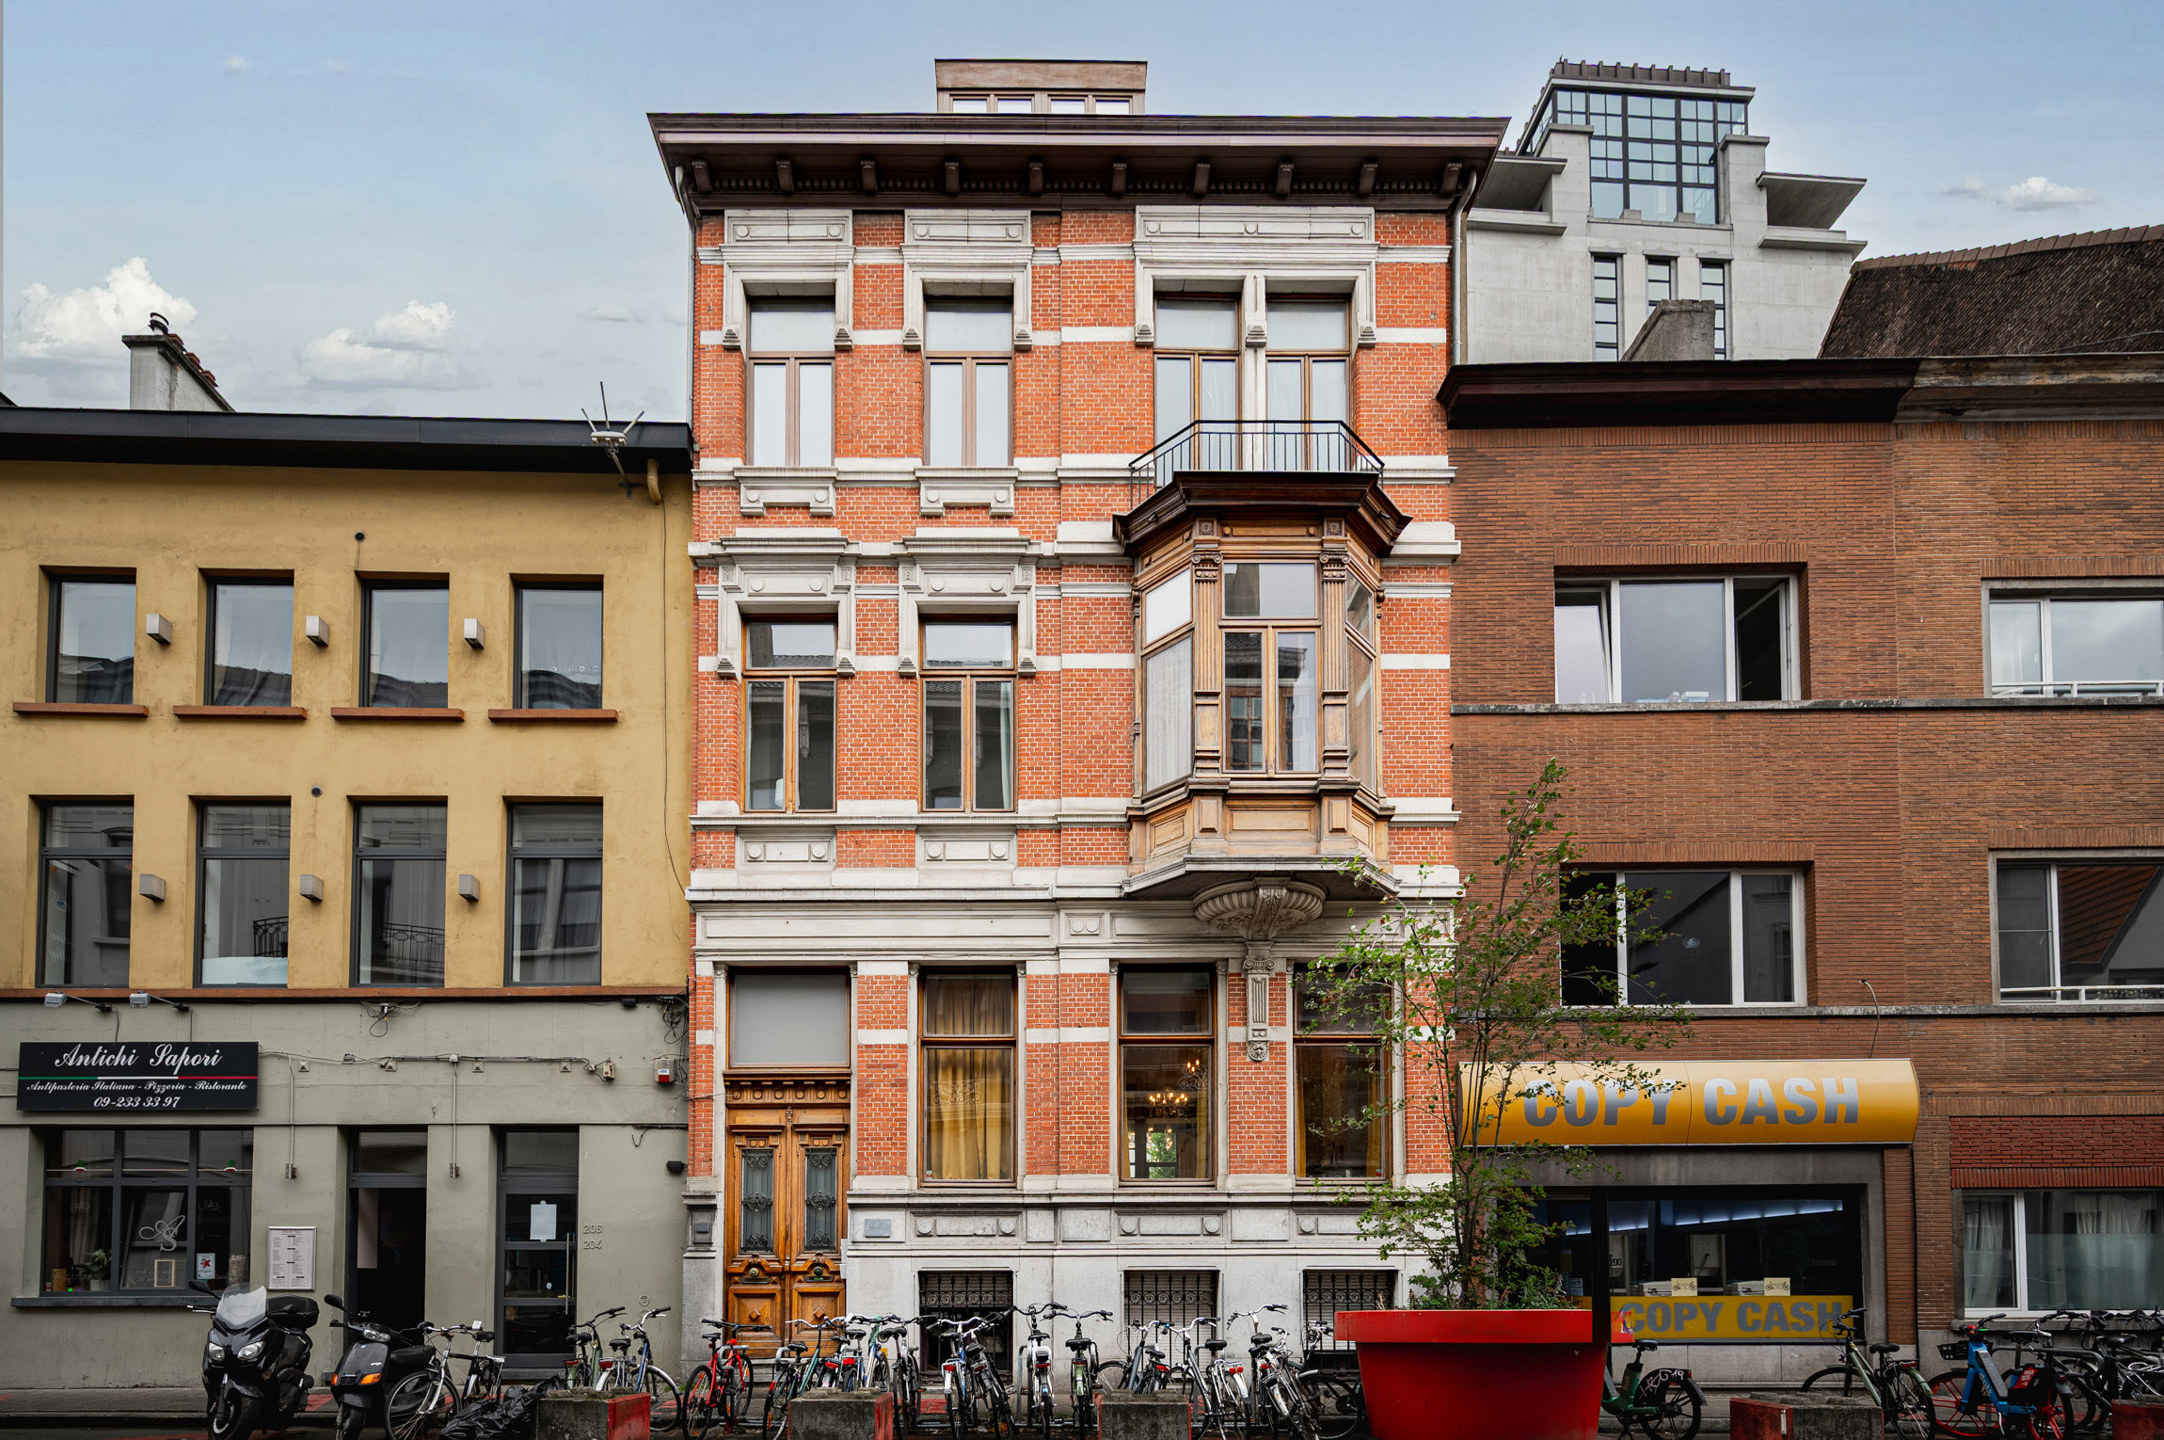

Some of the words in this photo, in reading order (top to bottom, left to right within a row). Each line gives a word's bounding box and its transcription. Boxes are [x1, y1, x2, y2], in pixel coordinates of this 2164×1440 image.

[54, 1044, 139, 1067] Antichi
[149, 1043, 223, 1075] Sapori
[26, 1081, 89, 1094] Antipasteria
[91, 1081, 135, 1091] Italiana
[144, 1081, 186, 1094] Pizzeria
[194, 1081, 248, 1091] Ristorante
[93, 1096, 141, 1108] 09-233
[142, 1096, 161, 1108] 33
[162, 1096, 181, 1108] 97
[1524, 1079, 1677, 1126] COPY
[1704, 1078, 1859, 1125] CASH
[1619, 1302, 1724, 1333] COPY
[1736, 1302, 1842, 1332] CASH
